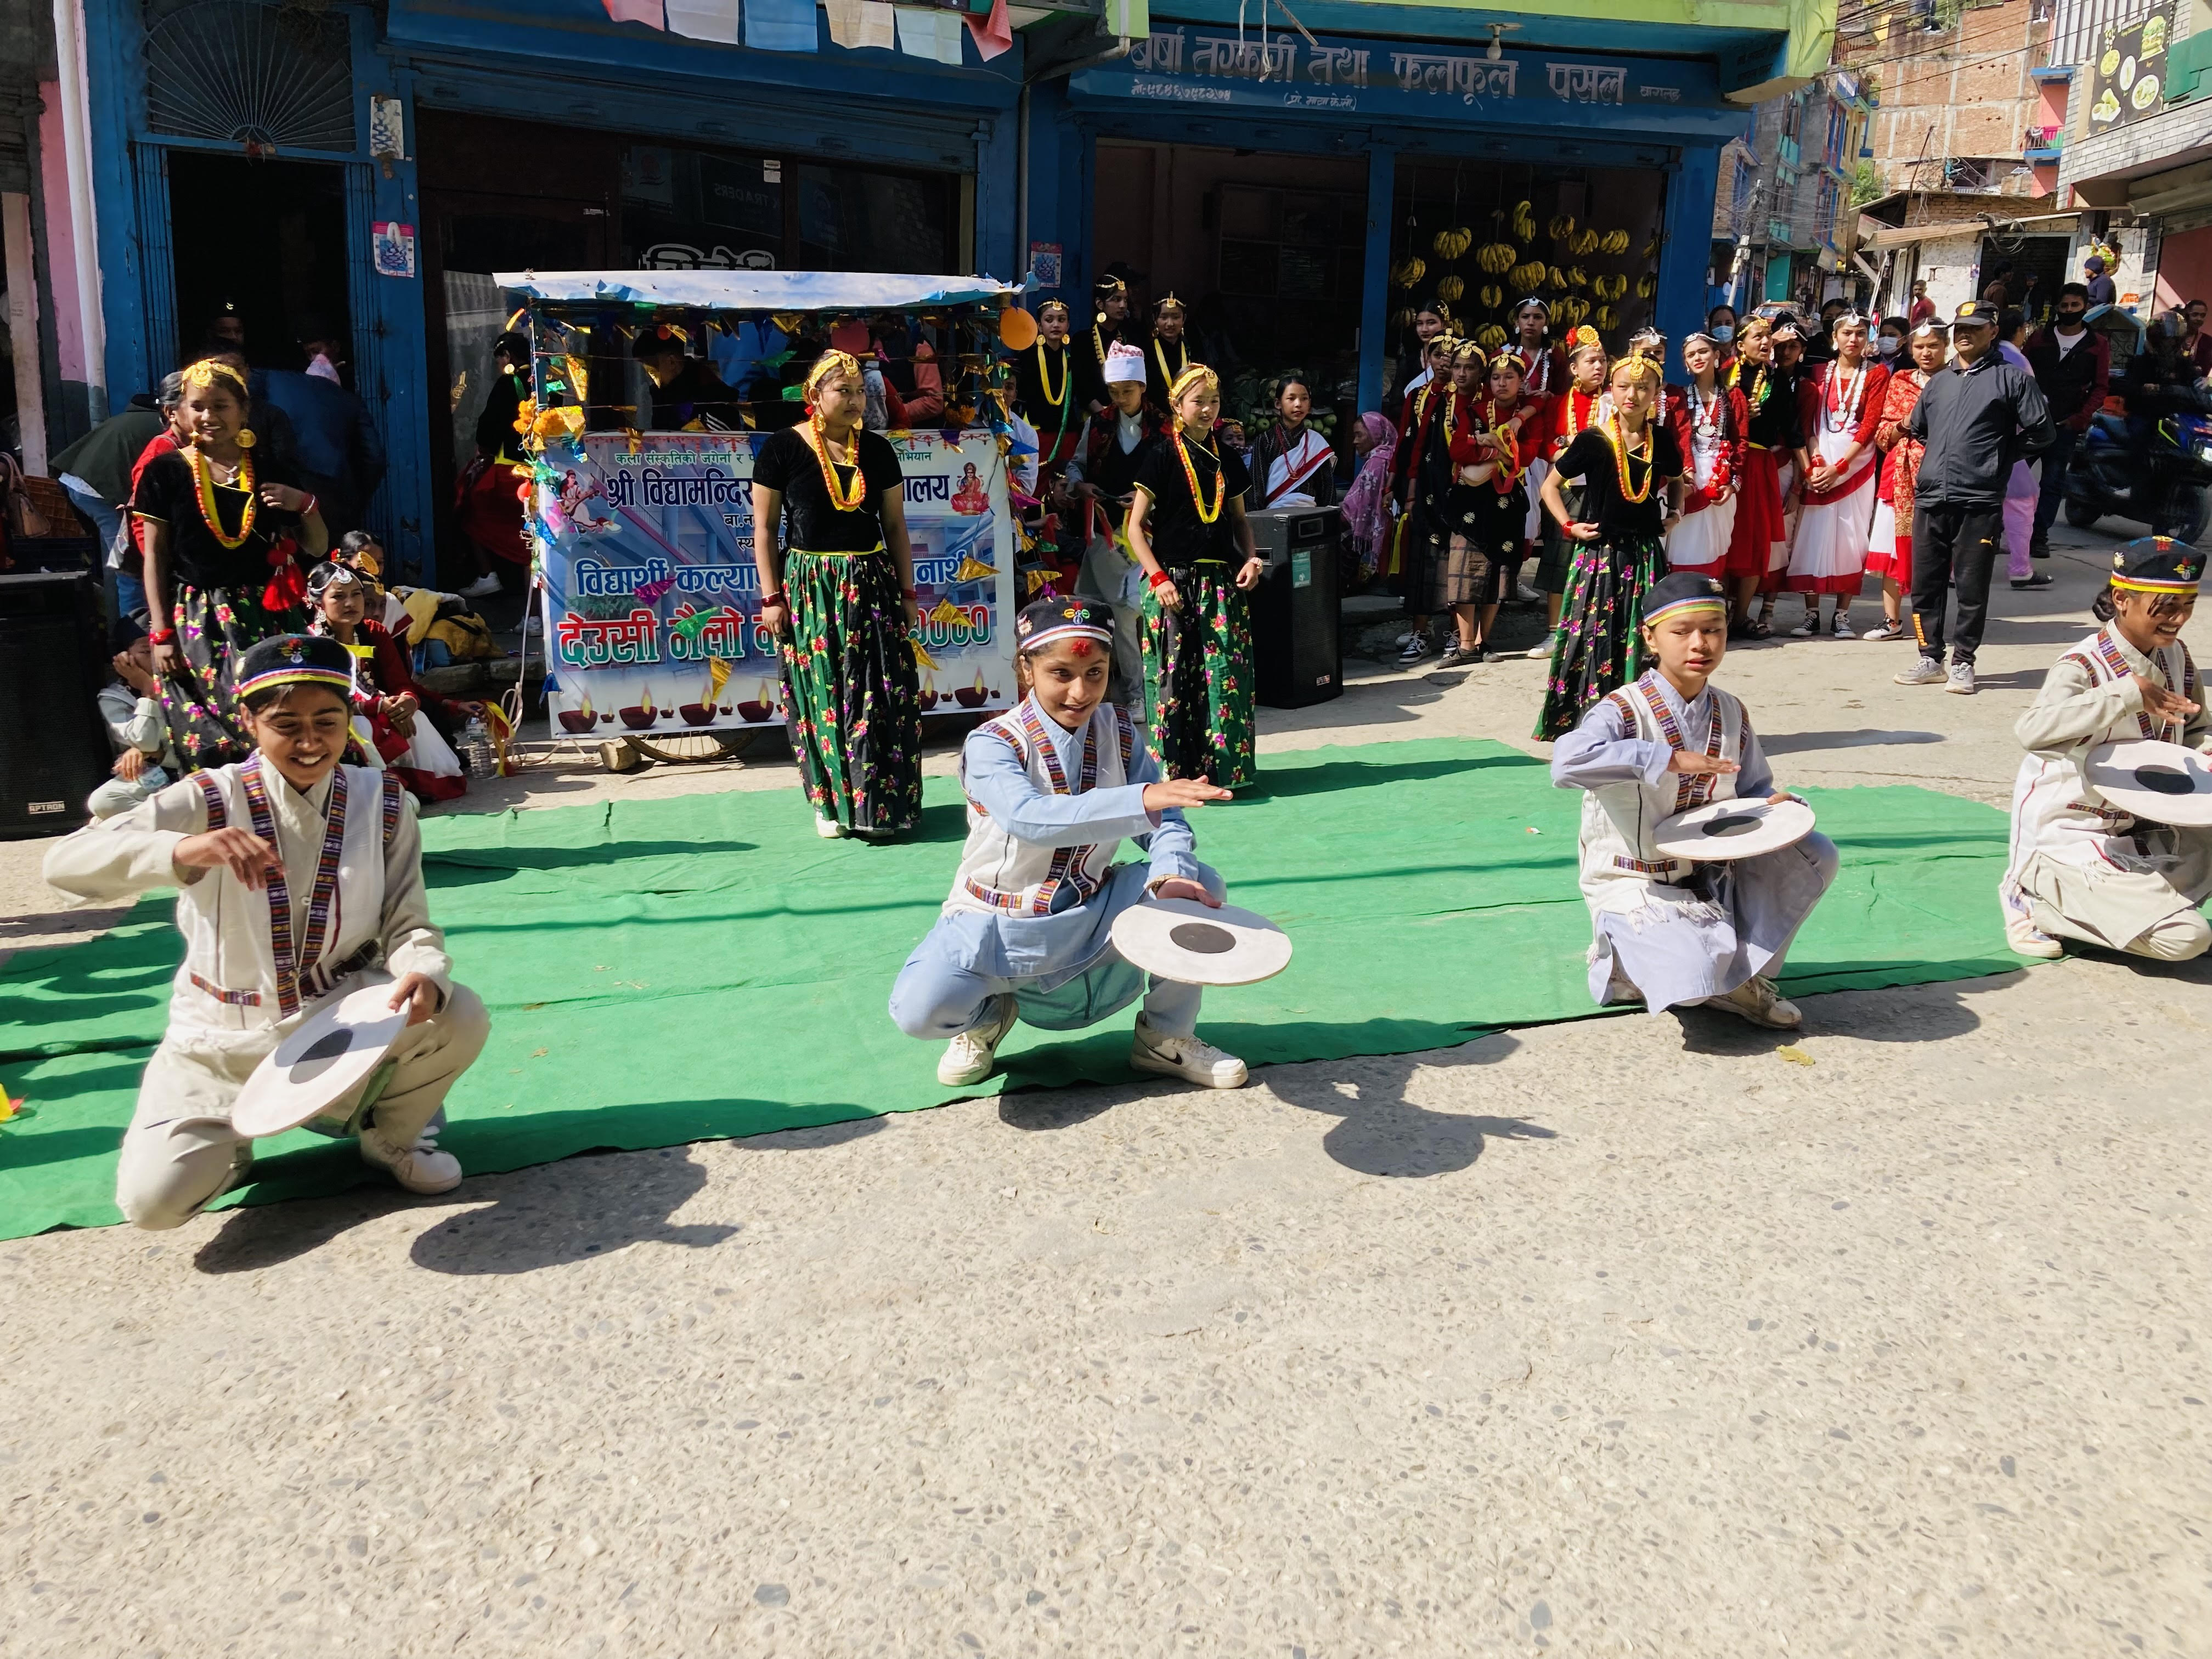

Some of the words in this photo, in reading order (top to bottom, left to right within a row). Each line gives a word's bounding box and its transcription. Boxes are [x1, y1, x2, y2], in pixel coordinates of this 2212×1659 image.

[1193, 34, 1297, 82] तरकारी
[1308, 46, 1370, 88] तथा
[1390, 52, 1519, 110] फलफूल
[1545, 61, 1627, 105] पसल
[616, 453, 641, 465] कला
[736, 454, 744, 464] र
[607, 469, 636, 508] श्री
[676, 565, 761, 592] कल्या
[558, 611, 658, 668] देउसी
